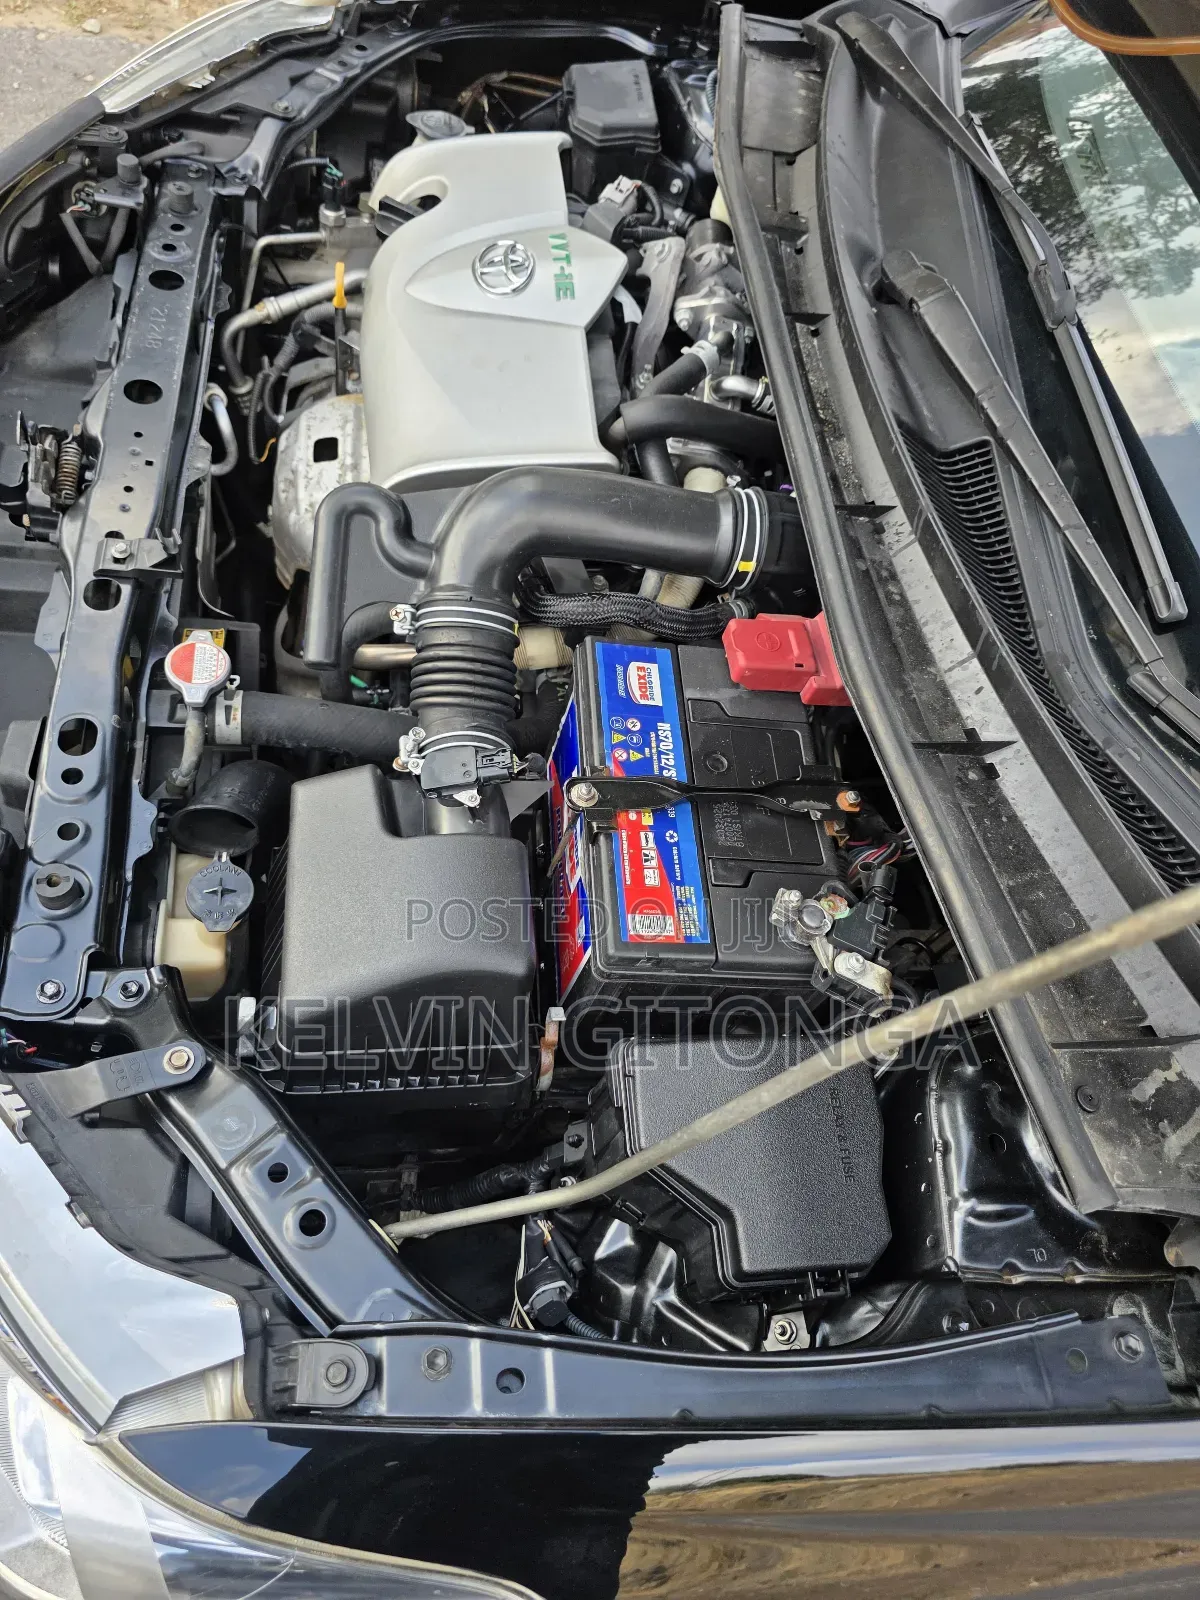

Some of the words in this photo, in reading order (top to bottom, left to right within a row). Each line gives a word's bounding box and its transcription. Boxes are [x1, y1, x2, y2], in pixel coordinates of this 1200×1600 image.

[636, 665, 650, 701] EXIDE
[646, 667, 656, 701] CHLORIDE
[657, 722, 677, 780] NS70/12/S
[199, 864, 242, 877] COOLANT
[840, 1148, 855, 1182] FUSE
